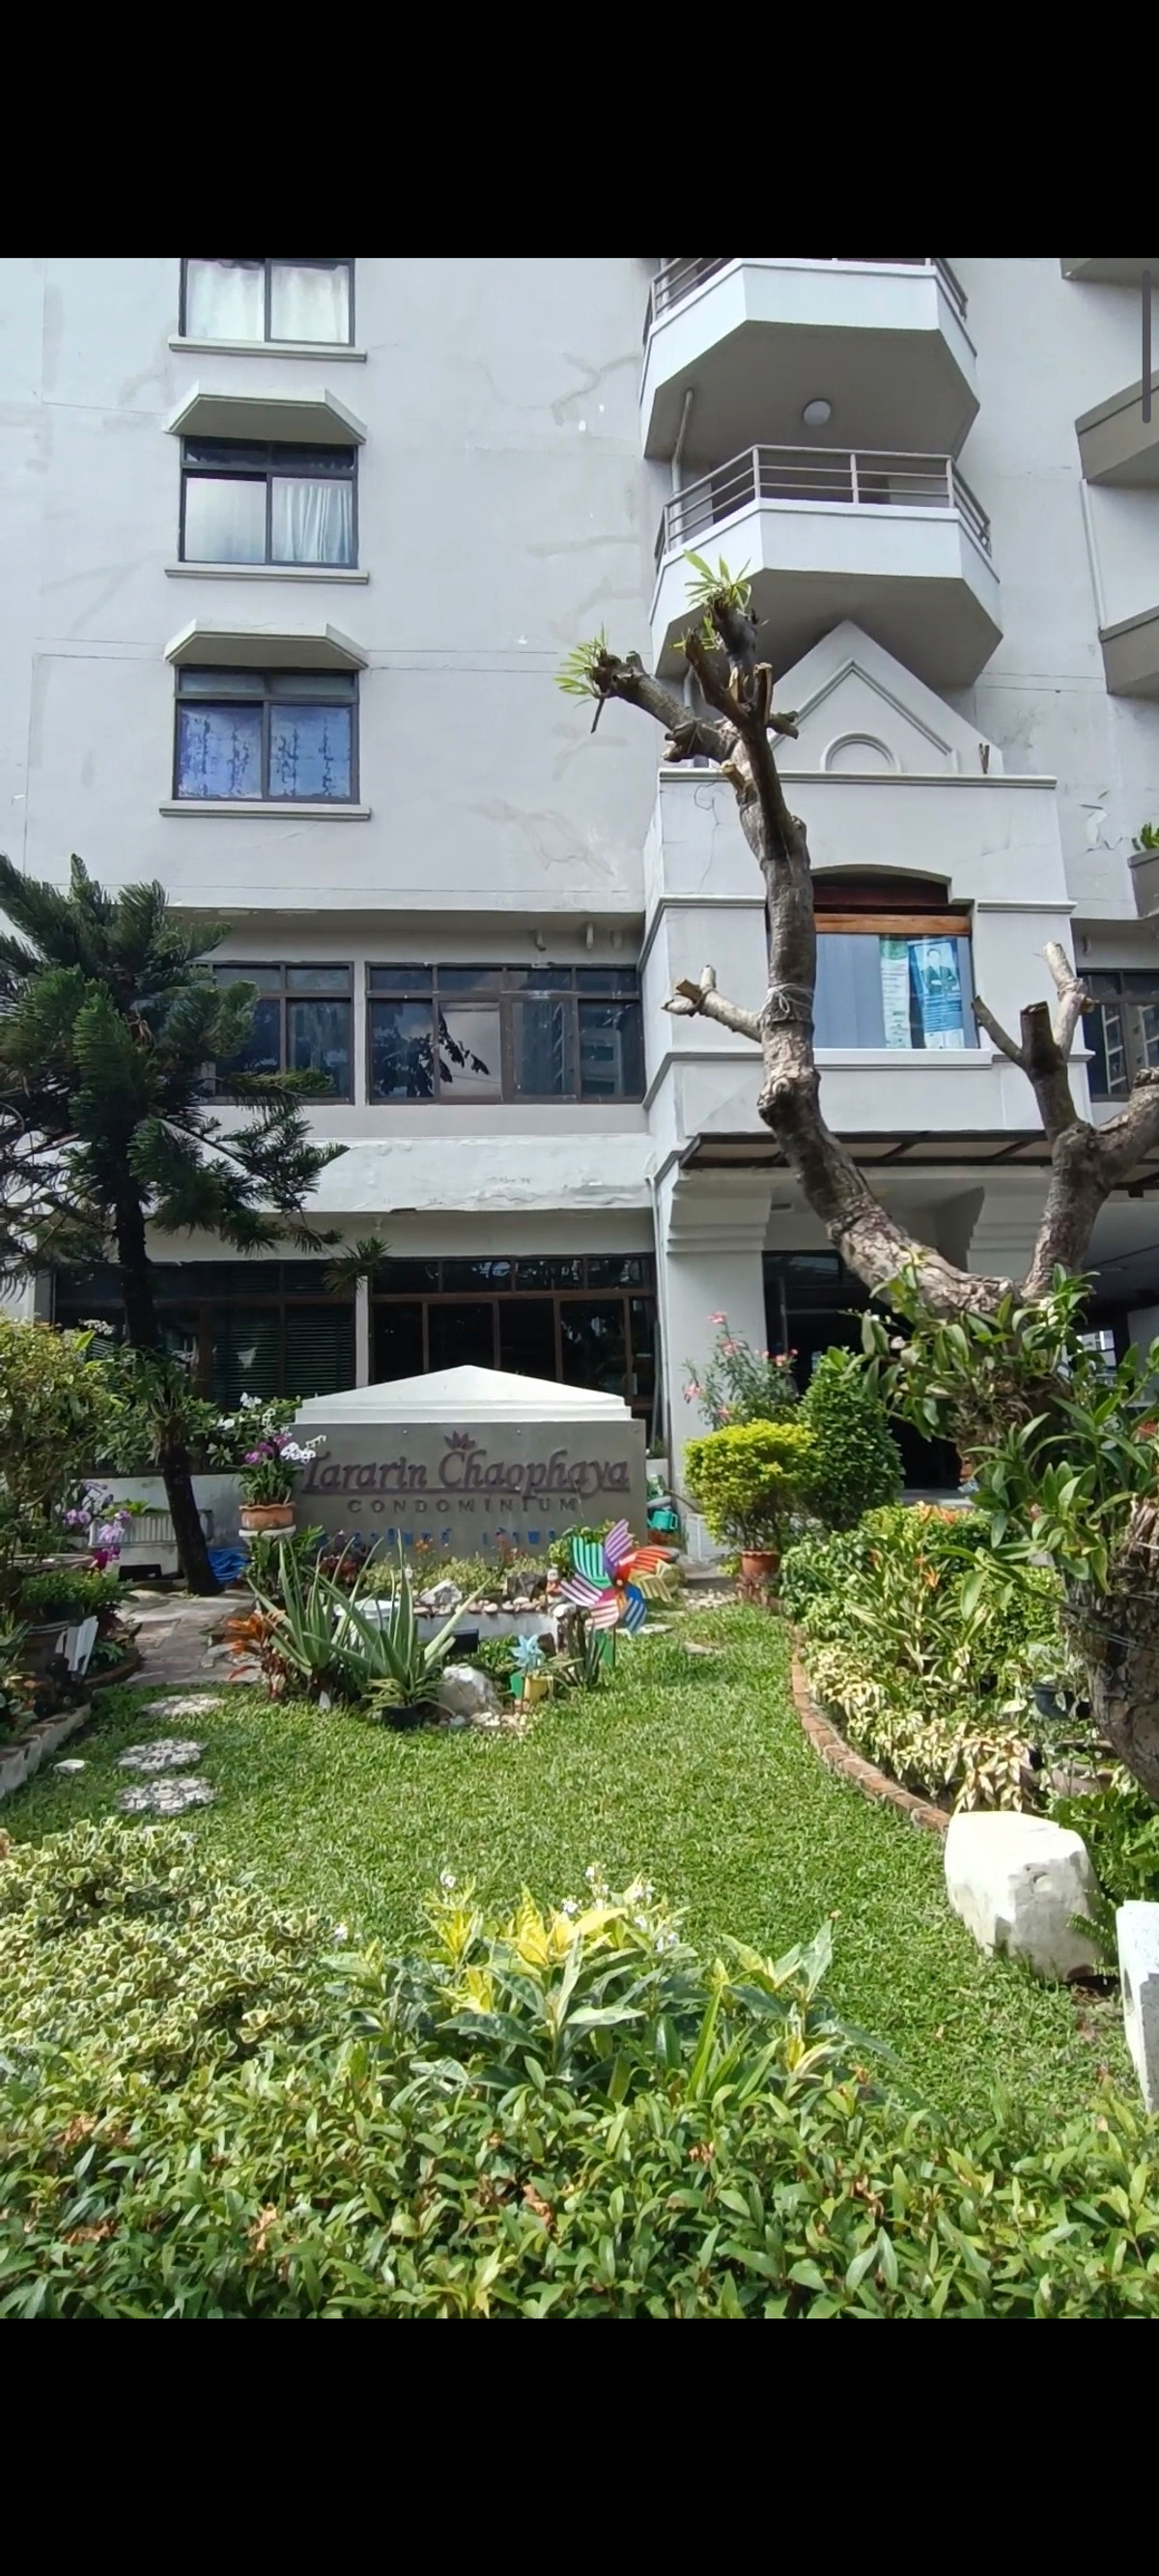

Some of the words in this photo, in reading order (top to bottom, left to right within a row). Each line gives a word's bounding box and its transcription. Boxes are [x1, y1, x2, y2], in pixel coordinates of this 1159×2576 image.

[302, 1451, 428, 1490] Tararin
[438, 1448, 630, 1499] Chaophaya
[348, 1498, 578, 1514] CONDOMINIUM
